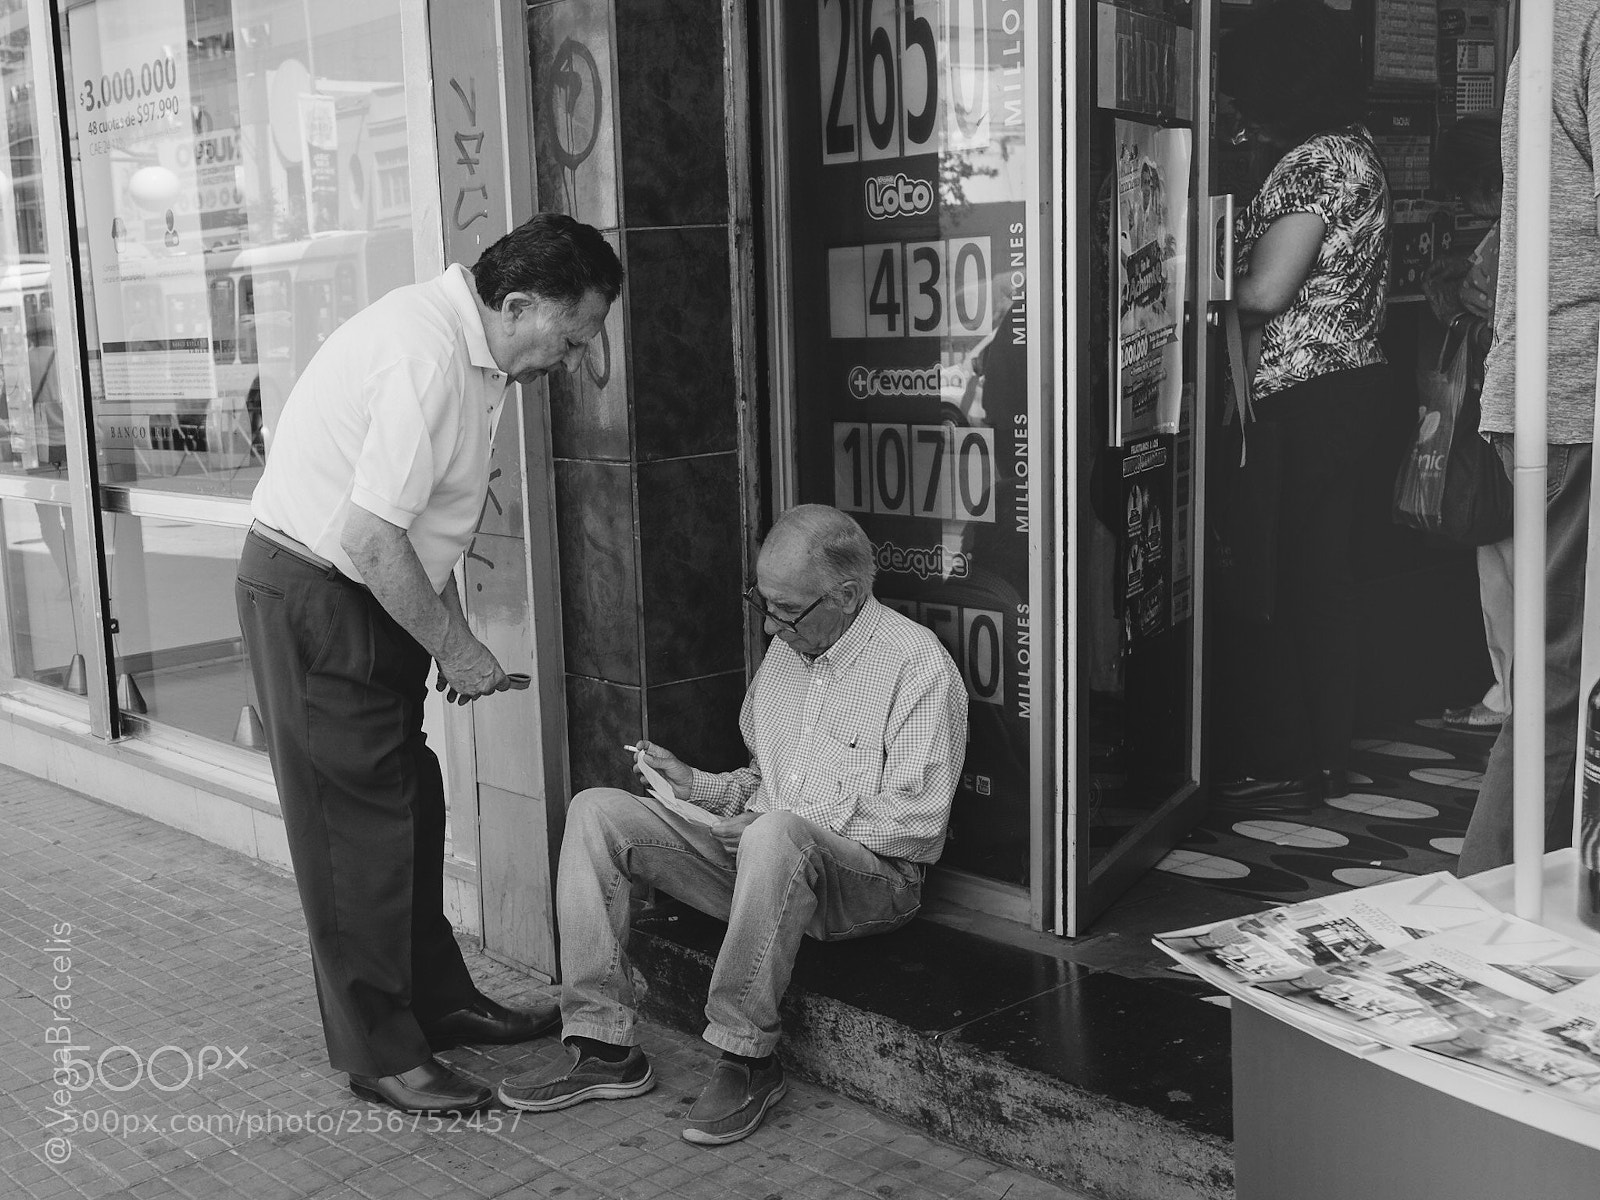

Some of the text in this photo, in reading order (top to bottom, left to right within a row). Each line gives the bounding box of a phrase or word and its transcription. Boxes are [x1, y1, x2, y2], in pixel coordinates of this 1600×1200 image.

[80, 56, 176, 112] $3.000.000
[88, 95, 179, 136] 48 cuotas de $97.990
[824, 0, 985, 155] 2650
[867, 177, 931, 215] Loto
[869, 242, 988, 332] 430
[1009, 221, 1027, 345] MILLONES
[110, 426, 147, 440] BANCO
[842, 427, 991, 517] 1070
[1013, 413, 1029, 533] MILLONES
[1016, 603, 1031, 719] MILLONES
